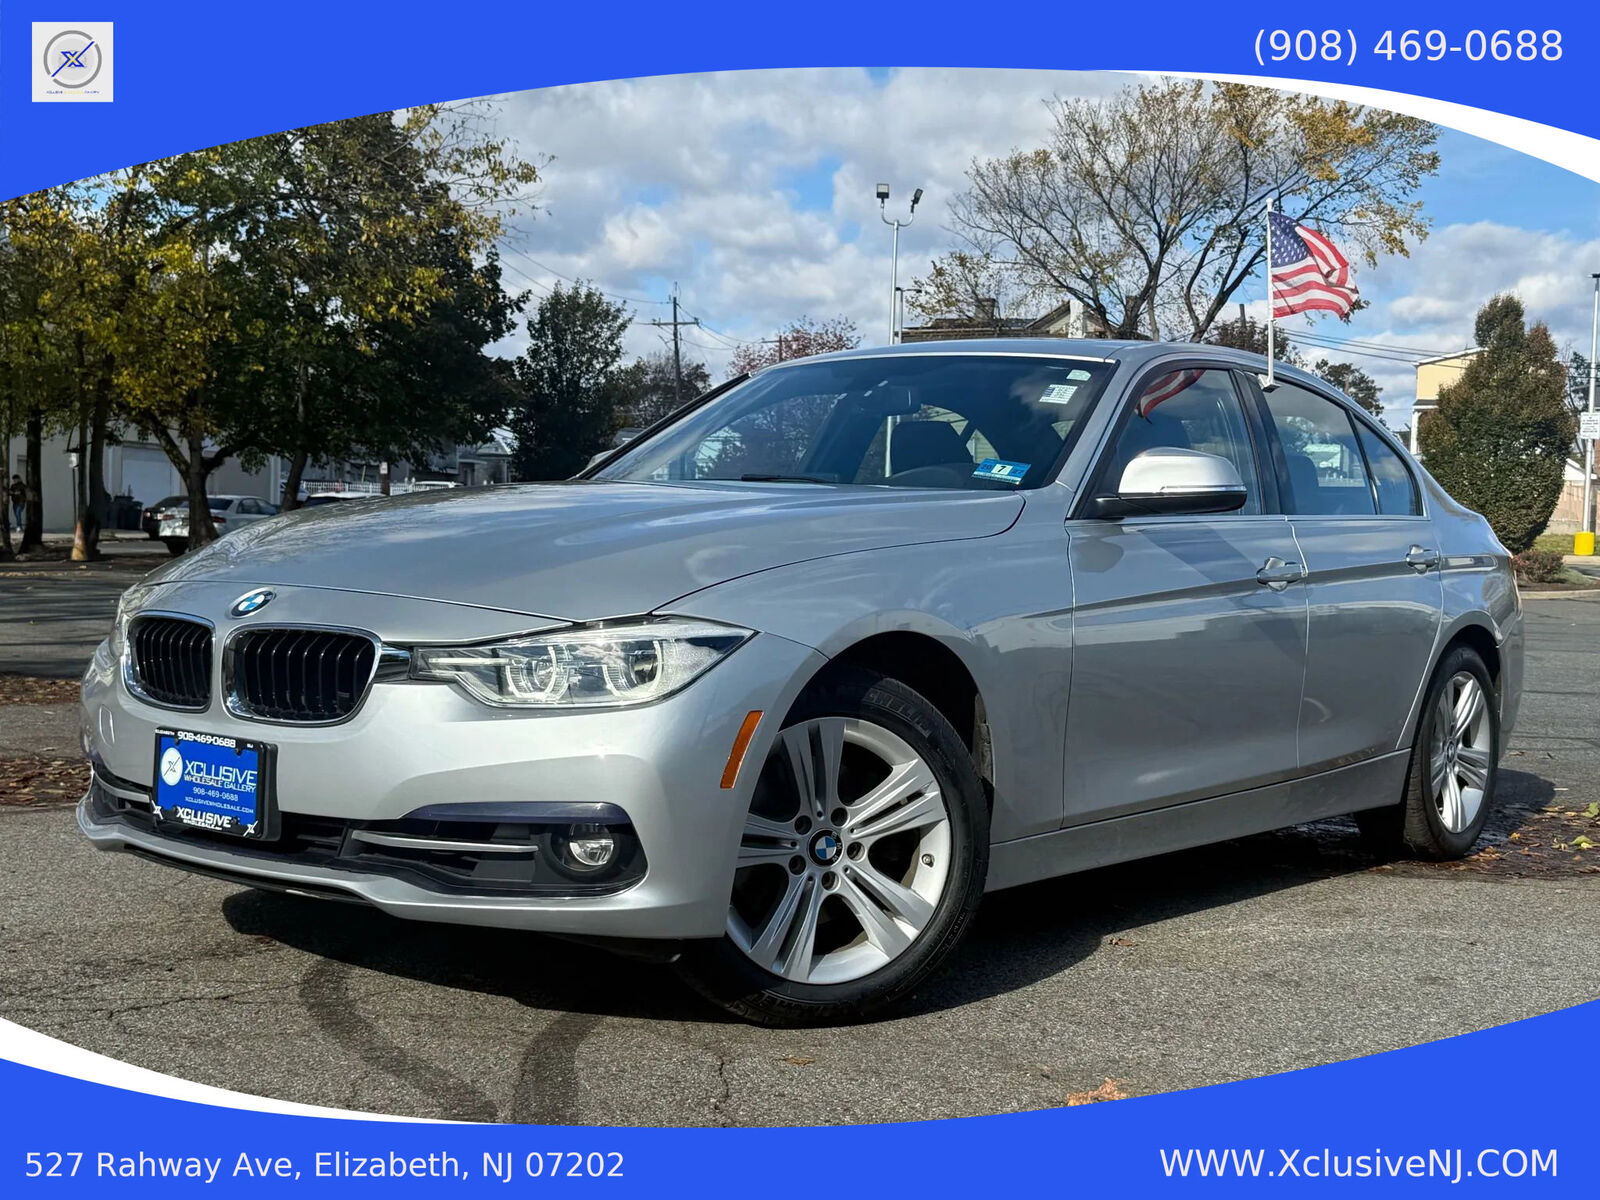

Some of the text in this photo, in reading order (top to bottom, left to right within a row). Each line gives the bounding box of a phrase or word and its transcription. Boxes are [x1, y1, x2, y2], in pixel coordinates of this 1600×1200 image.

[184, 760, 257, 785] XCLUSIVE
[184, 775, 256, 792] WHOLESALE GALLERY
[177, 806, 231, 828] XCLUSIVE
